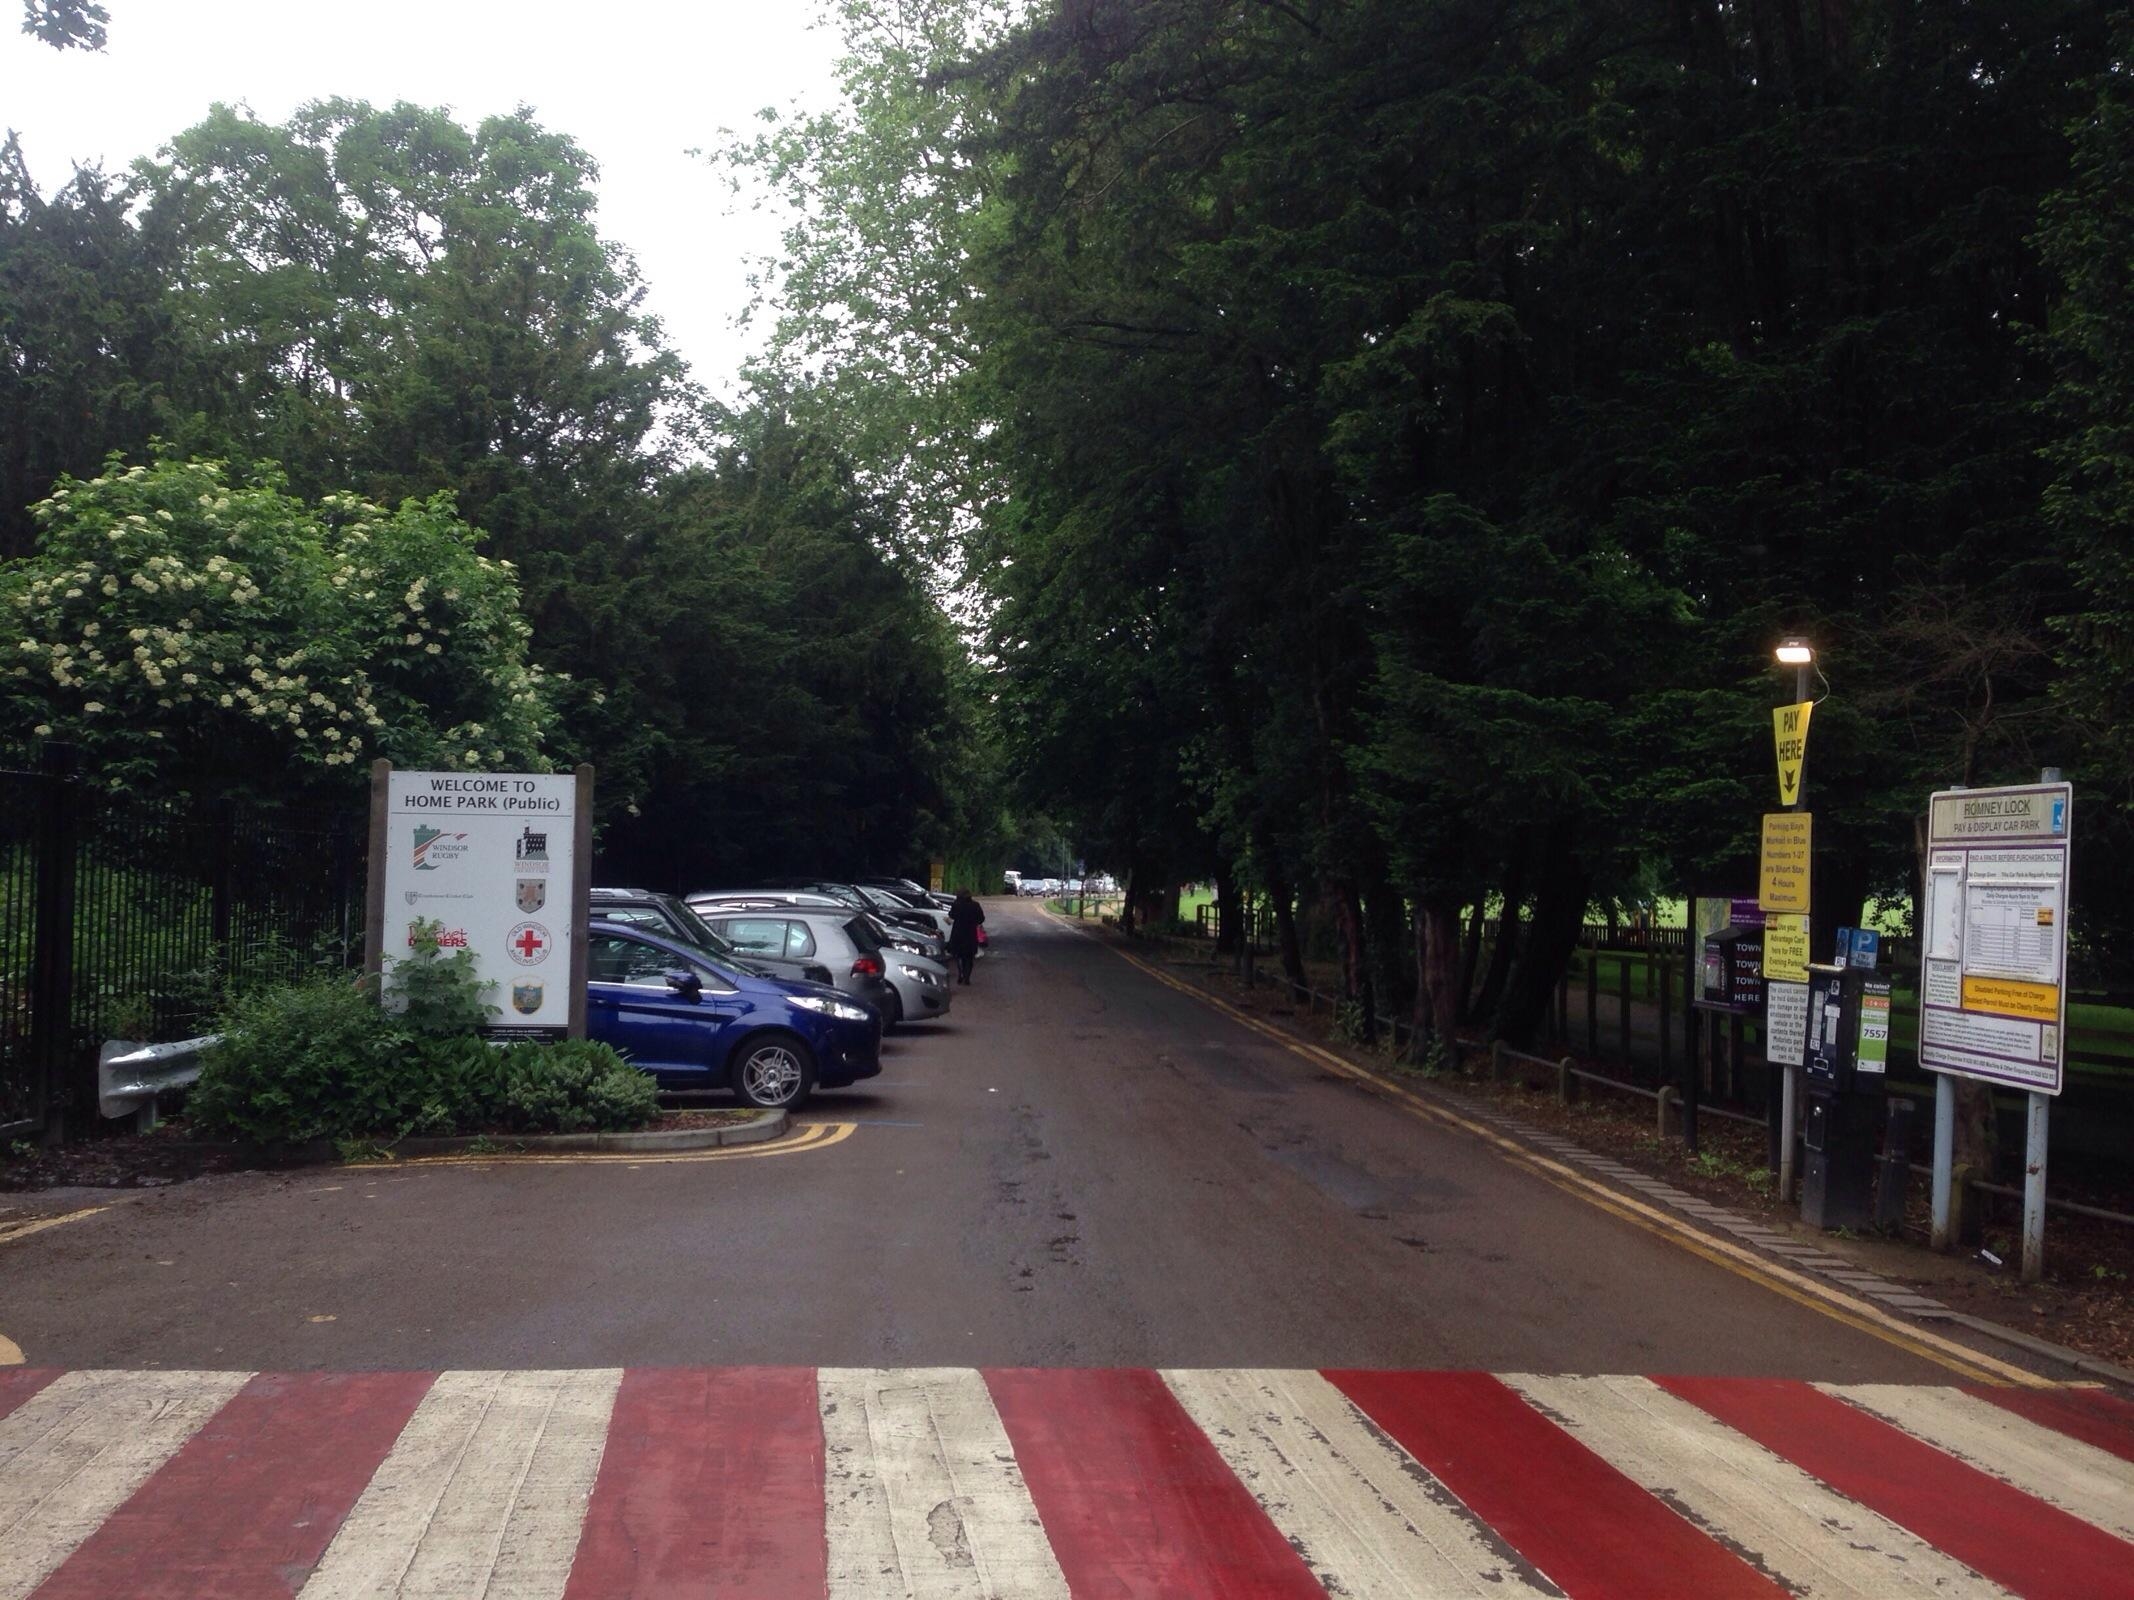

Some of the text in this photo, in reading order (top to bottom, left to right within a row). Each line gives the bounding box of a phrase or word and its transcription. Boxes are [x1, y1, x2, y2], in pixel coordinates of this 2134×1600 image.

[1784, 710, 1800, 733] PAY
[1779, 739, 1802, 762] HERE
[431, 779, 536, 793] WELCOME TO
[405, 795, 560, 811] HOME PARK (Public)
[1965, 800, 2031, 815] ROMNEY LOCK
[1954, 820, 2040, 832] PAY & DISPLAY CAR PARK
[1793, 836, 1806, 844] Blue
[1767, 850, 1791, 858] Numbers
[1775, 865, 1790, 873] Short
[1792, 865, 1804, 875] Stay
[1772, 876, 1795, 888] 4 Hours
[1770, 892, 1797, 901] Maximum
[1858, 933, 1872, 950] P
[1736, 944, 1761, 952] TOWN
[1789, 947, 1803, 956] FREE
[1736, 960, 1761, 969] TOWN
[1736, 977, 1761, 985] TOWN
[2012, 988, 2021, 996] Free
[1734, 993, 1761, 1002] HERE
[1864, 1028, 1887, 1039] 7557
